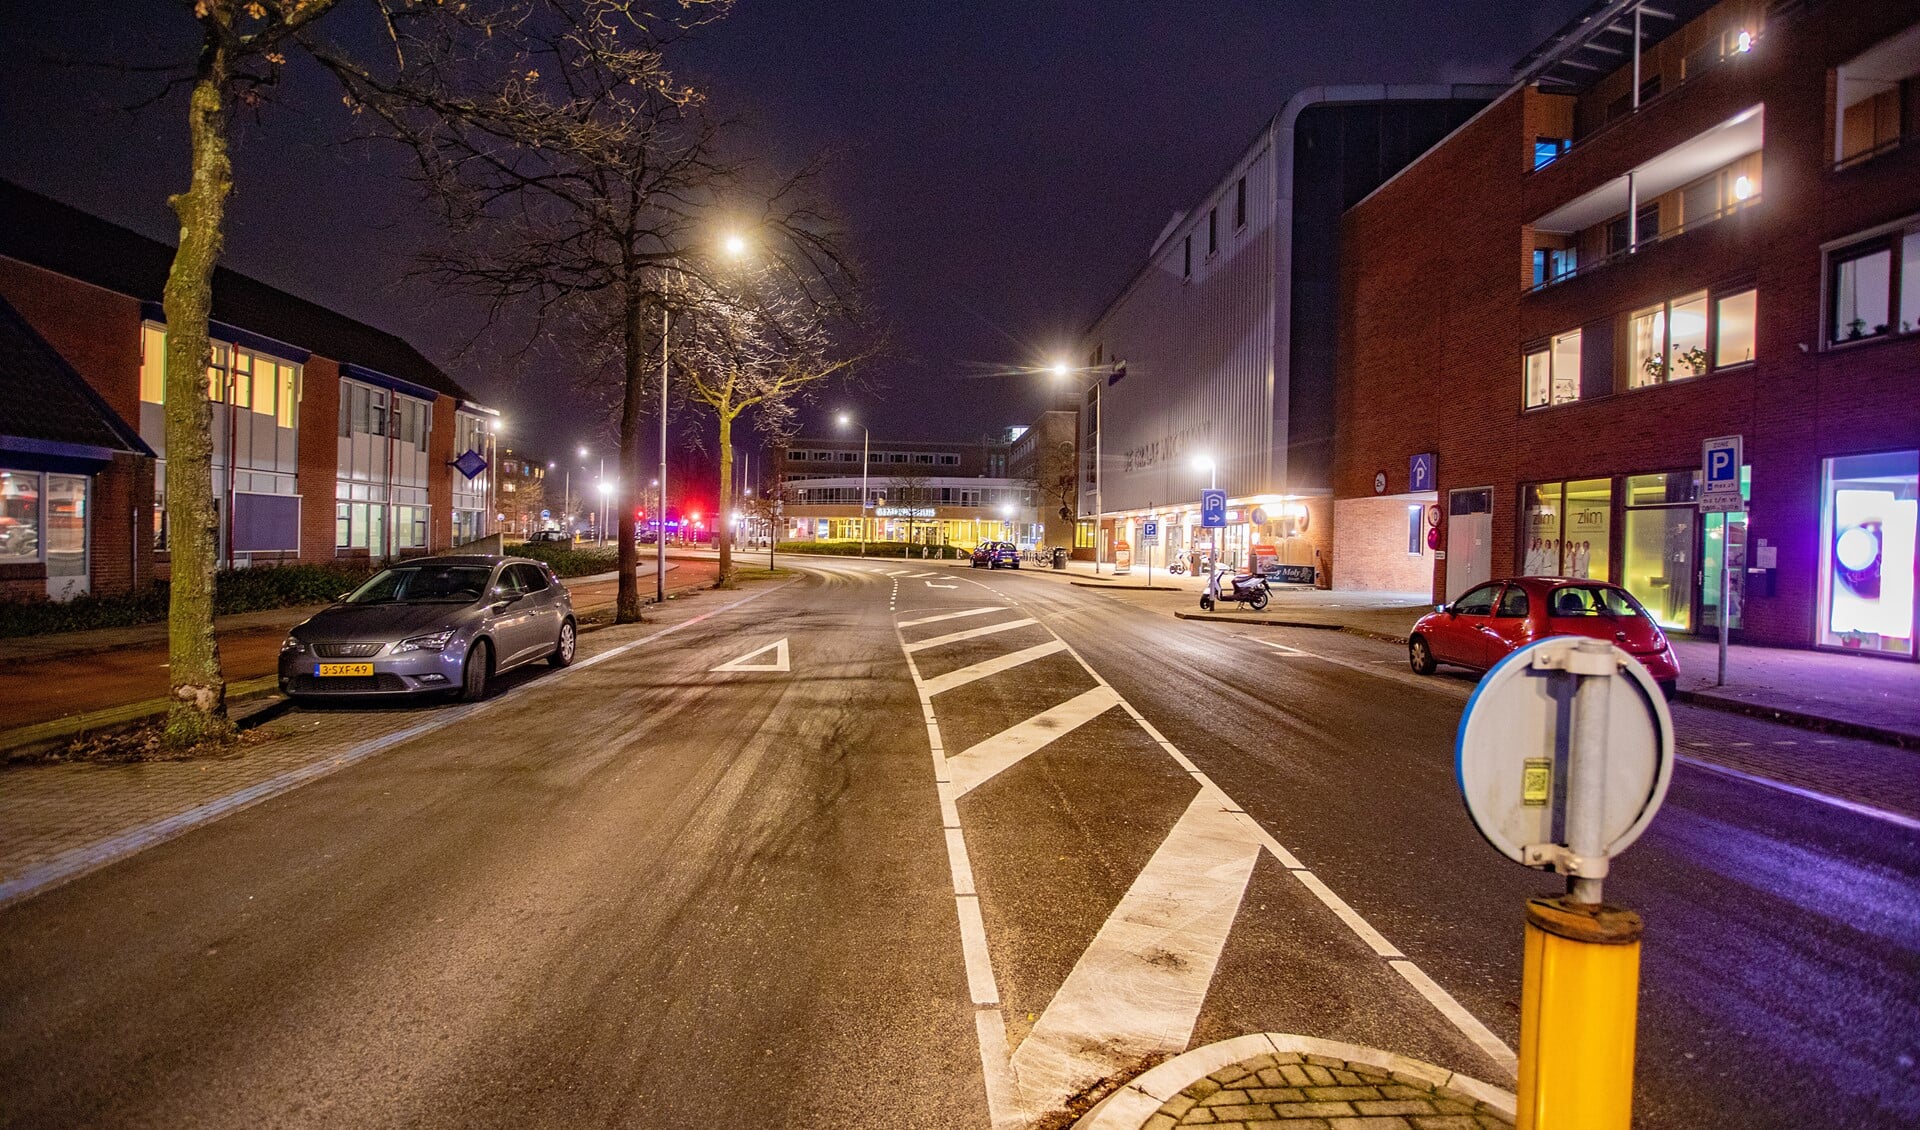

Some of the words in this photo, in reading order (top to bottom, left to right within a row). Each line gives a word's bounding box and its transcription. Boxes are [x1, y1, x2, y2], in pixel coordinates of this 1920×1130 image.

[1713, 451, 1729, 479] P
[1416, 467, 1425, 488] P
[1210, 499, 1220, 510] P
[1532, 510, 1555, 525] zlim
[1577, 508, 1603, 525] zlim
[1146, 524, 1154, 534] P
[322, 665, 368, 675] 3-SXF-49
